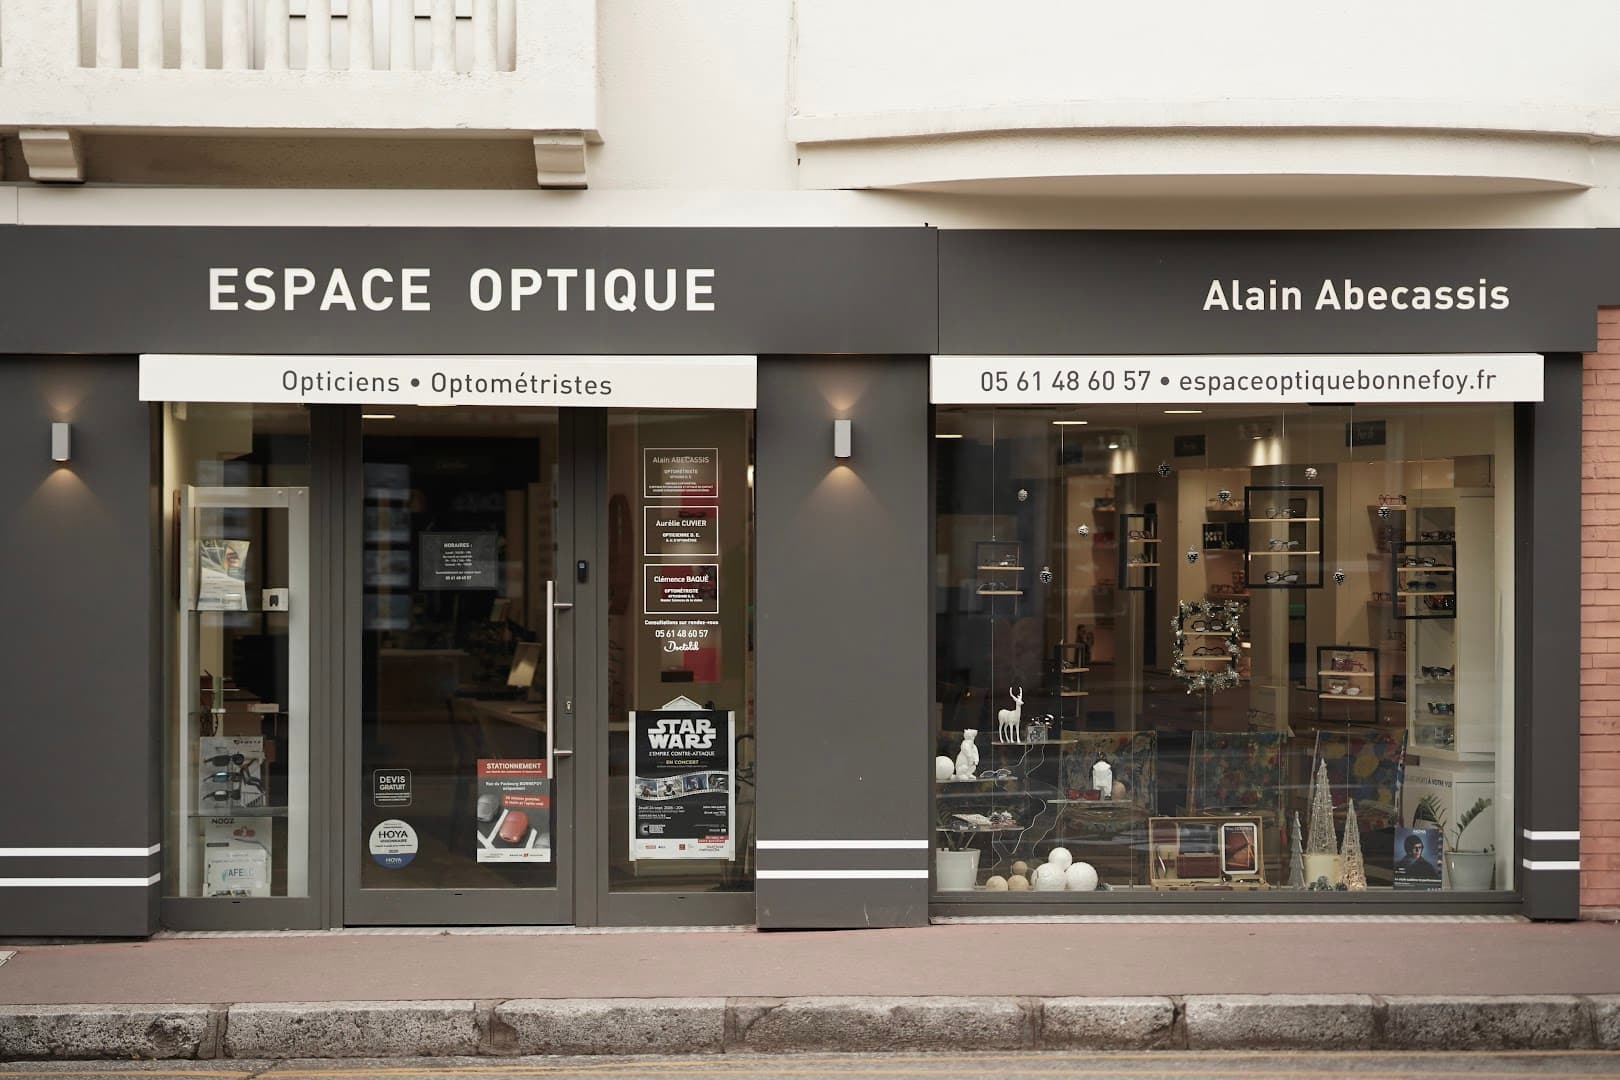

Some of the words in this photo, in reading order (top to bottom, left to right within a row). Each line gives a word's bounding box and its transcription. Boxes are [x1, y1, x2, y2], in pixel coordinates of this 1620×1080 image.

[209, 267, 431, 312] ESPACE
[469, 267, 715, 313] OPTIQUE
[1202, 279, 1302, 311] Alain
[1314, 278, 1510, 311] Abecassis
[282, 370, 400, 397] Opticiens
[431, 371, 612, 398] Optométristes
[981, 371, 1008, 392] 05
[1016, 370, 1040, 392] 61
[1051, 370, 1080, 391] 48
[1088, 370, 1115, 391] 60
[1124, 370, 1151, 391] 57
[1179, 369, 1497, 396] espaceoptiquebonnefoy.fr
[652, 456, 670, 464] Alain
[671, 456, 710, 464] ABECASSIS
[686, 574, 709, 582] BAQUÉ
[656, 630, 665, 638] 05
[666, 630, 675, 638] 61
[677, 630, 687, 638] 48
[688, 630, 698, 638] 60
[699, 630, 708, 638] 57
[648, 719, 716, 734] STAR
[648, 734, 716, 749] WARS
[380, 776, 406, 784] DEVIS
[378, 830, 408, 839] HOYA
